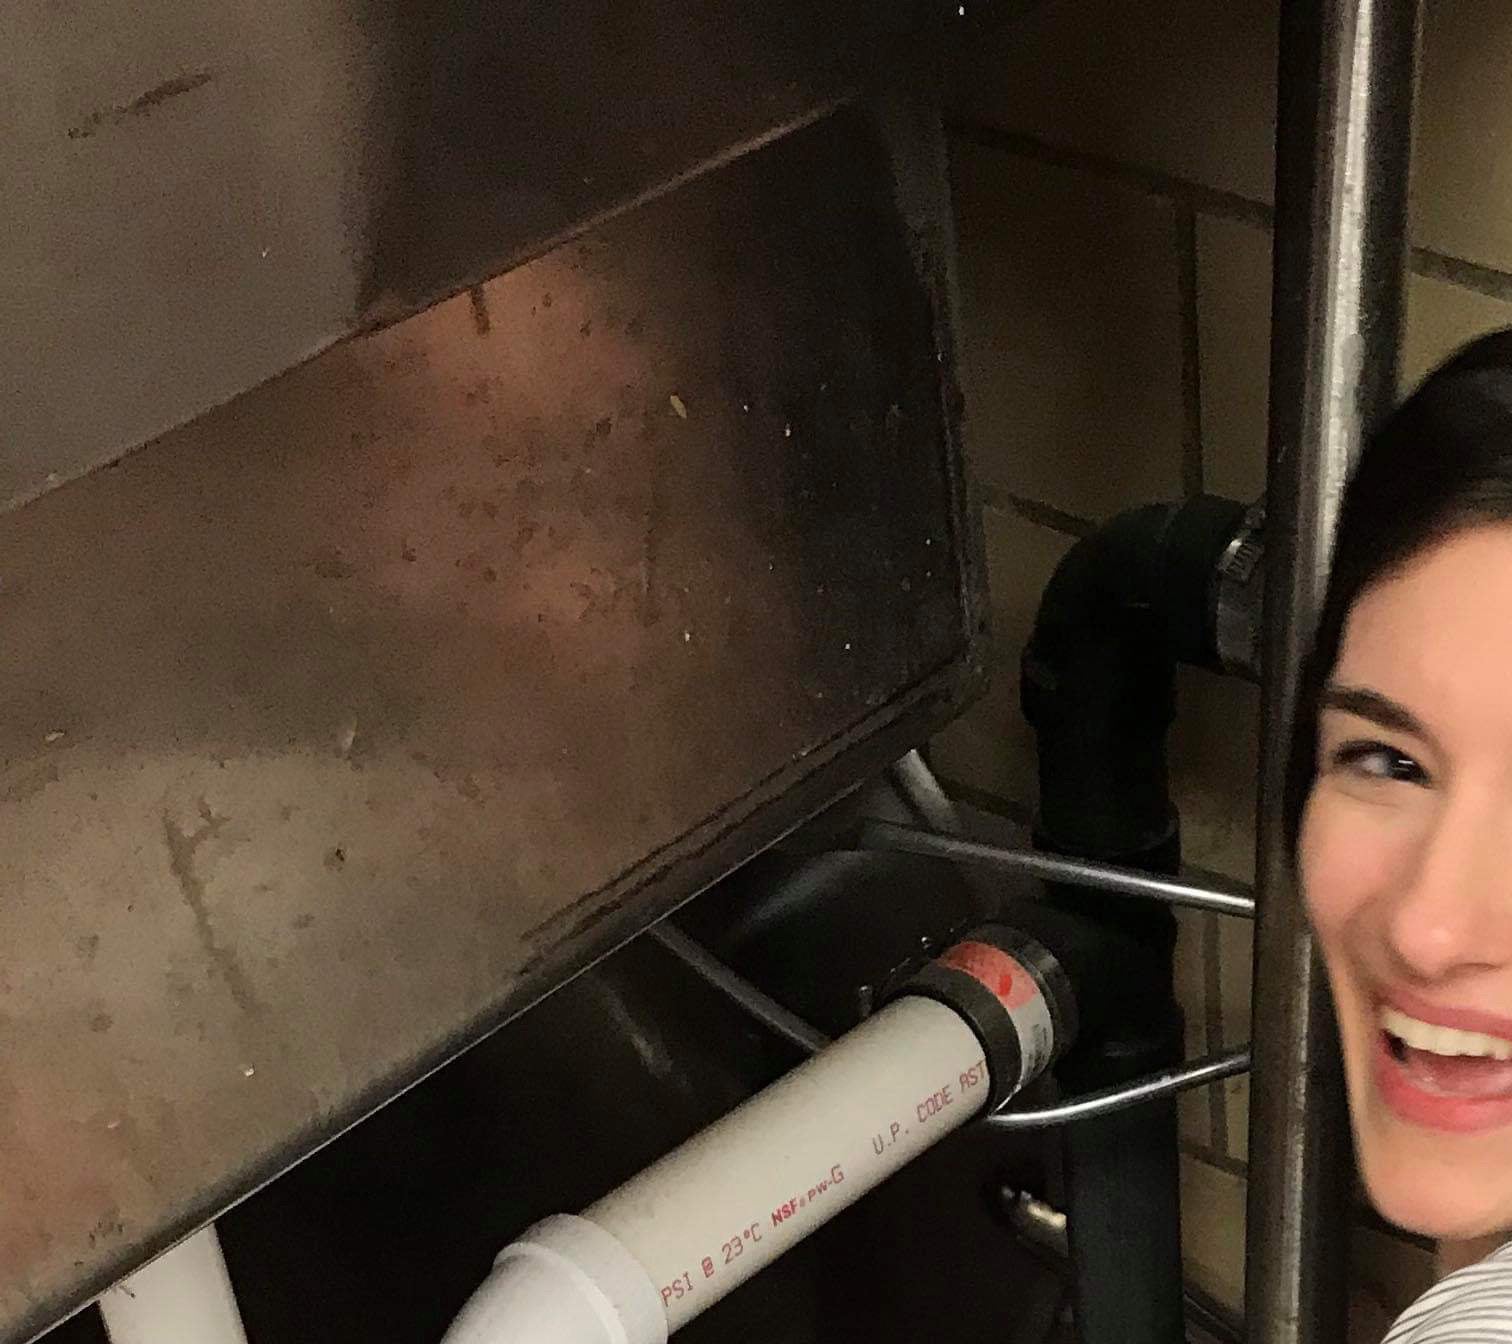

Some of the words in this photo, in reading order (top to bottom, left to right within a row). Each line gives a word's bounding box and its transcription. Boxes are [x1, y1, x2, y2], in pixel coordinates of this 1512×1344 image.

[660, 1271, 693, 1307] PSI
[722, 1221, 761, 1264] 23°C
[916, 1084, 953, 1123] CODE
